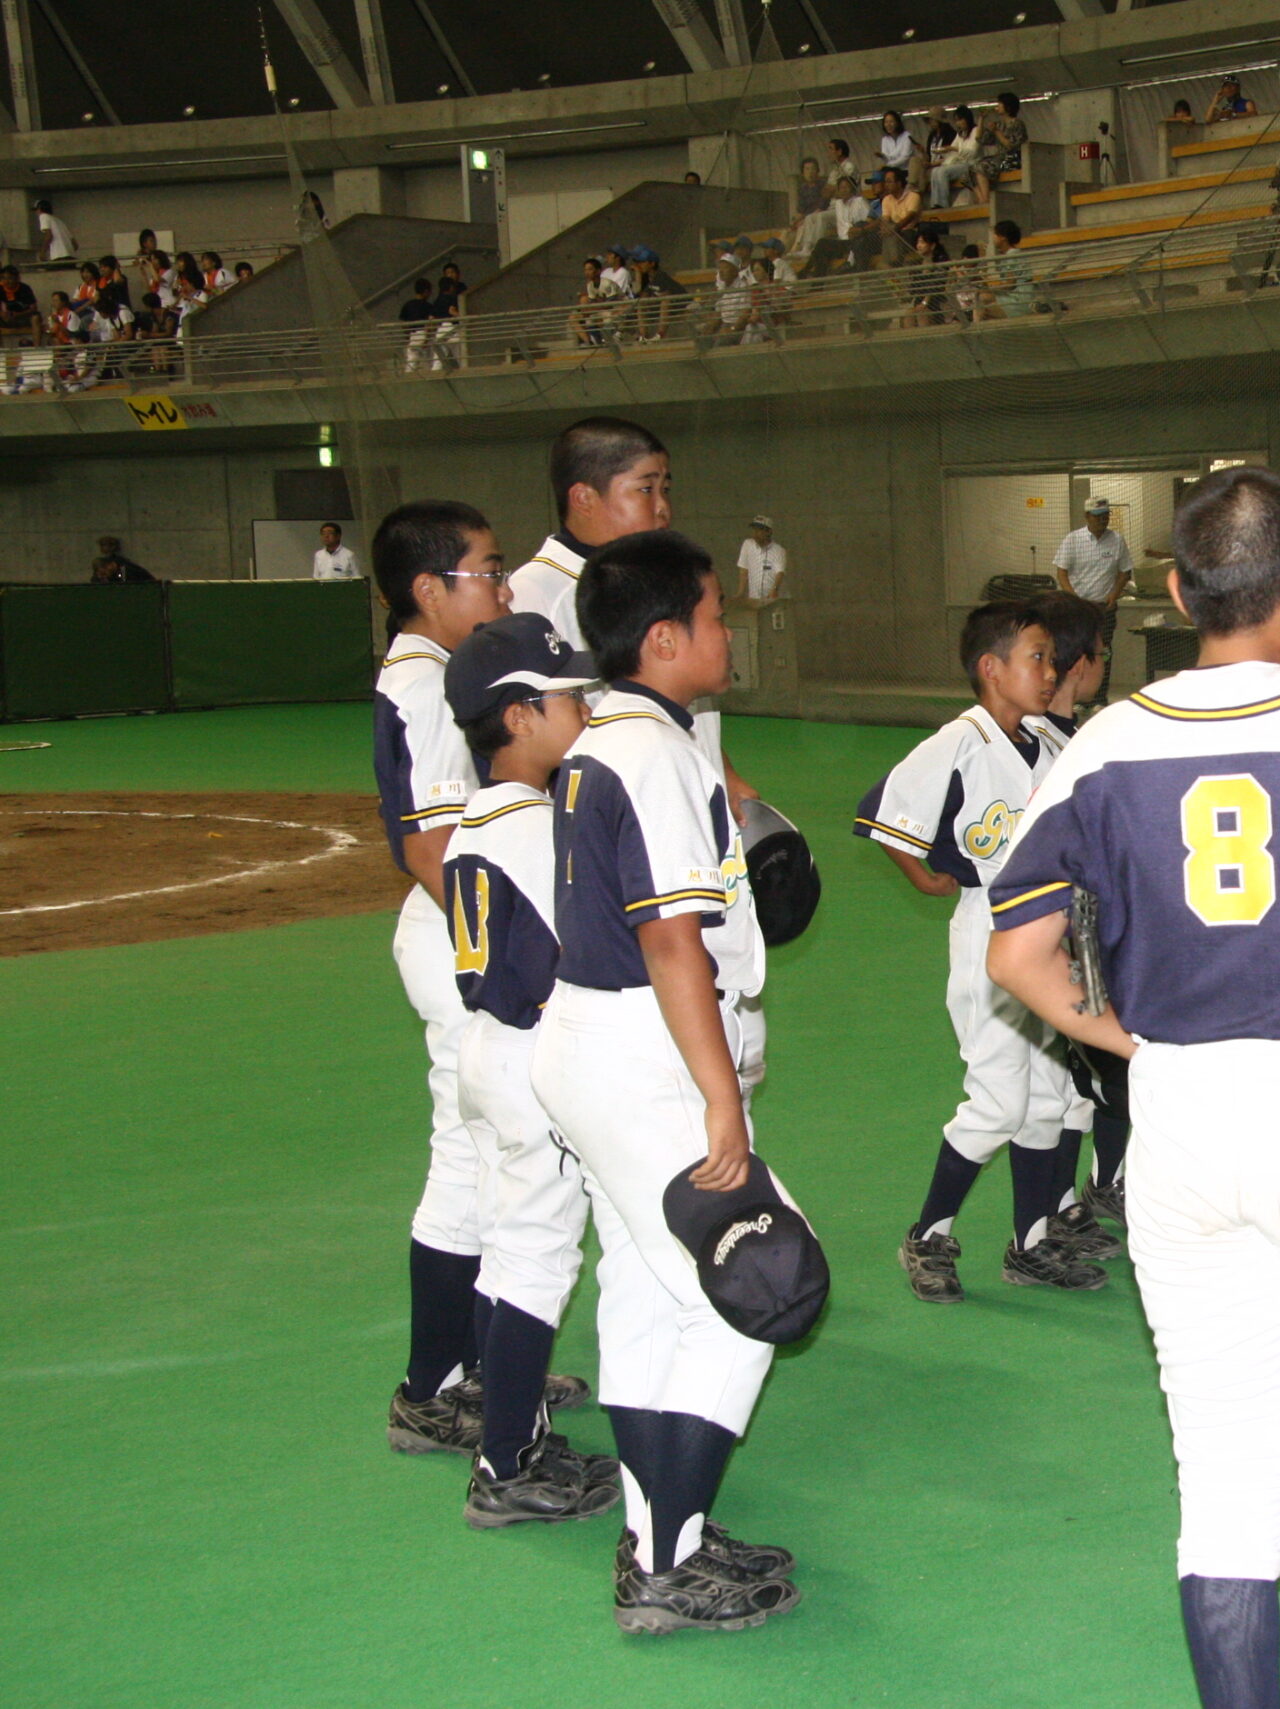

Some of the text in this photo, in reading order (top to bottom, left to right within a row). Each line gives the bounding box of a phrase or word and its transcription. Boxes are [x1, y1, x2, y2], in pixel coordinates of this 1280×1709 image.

[127, 401, 178, 425] トイレ
[1180, 773, 1276, 927] 8
